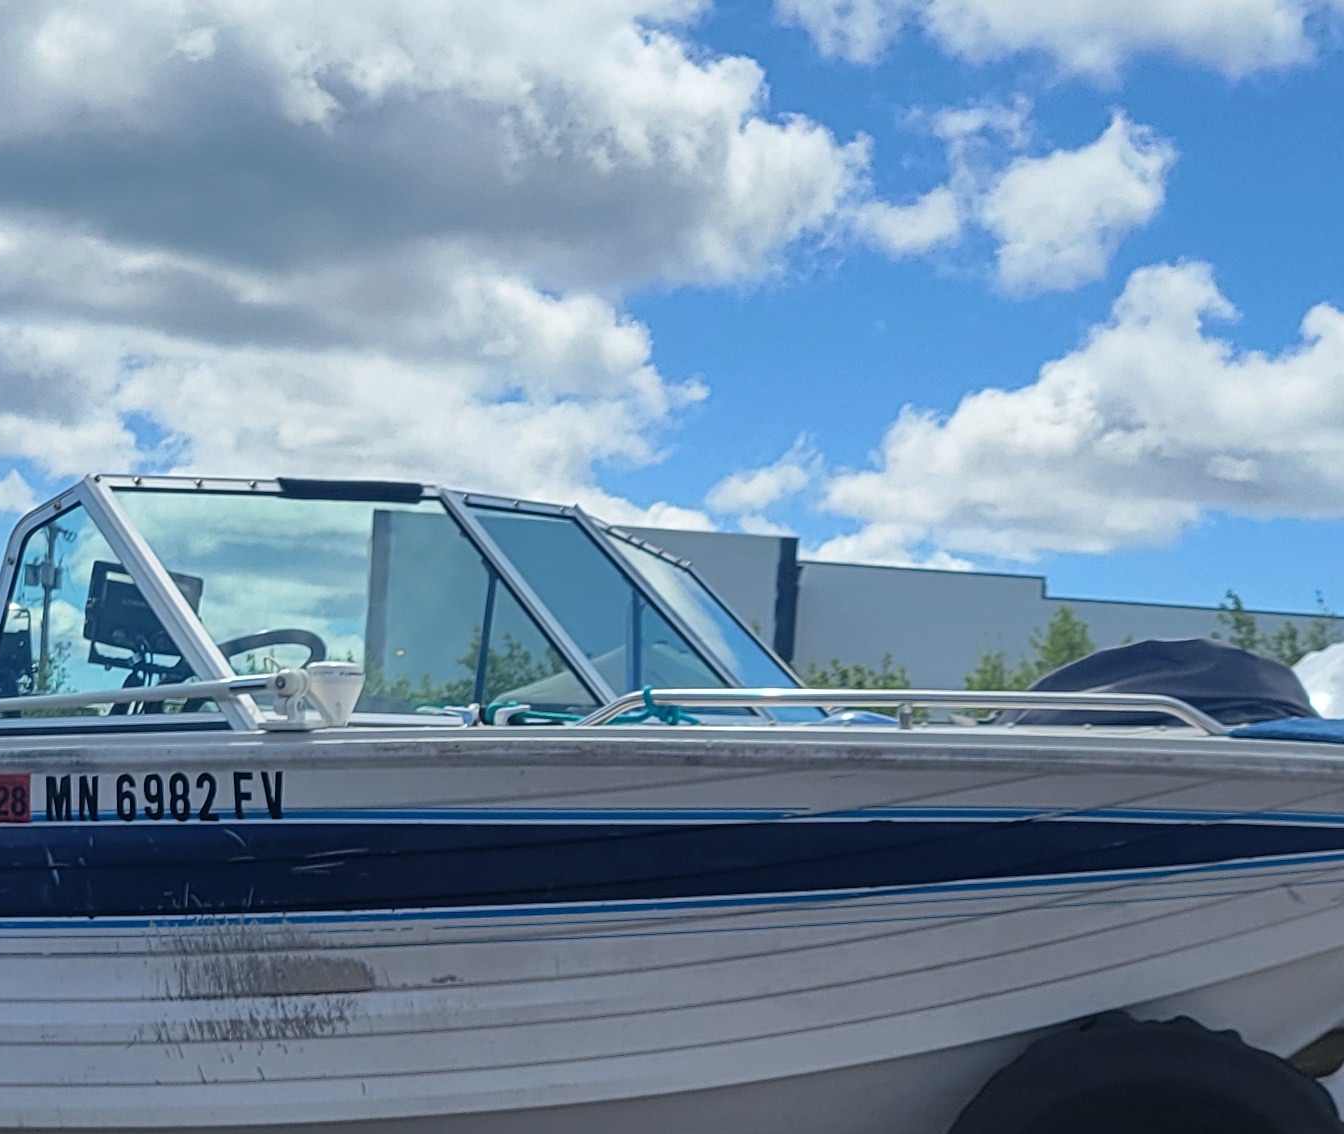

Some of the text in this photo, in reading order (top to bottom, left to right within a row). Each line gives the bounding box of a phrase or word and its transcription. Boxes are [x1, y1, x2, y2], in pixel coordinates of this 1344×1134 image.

[46, 771, 283, 821] MN 6982 FV
